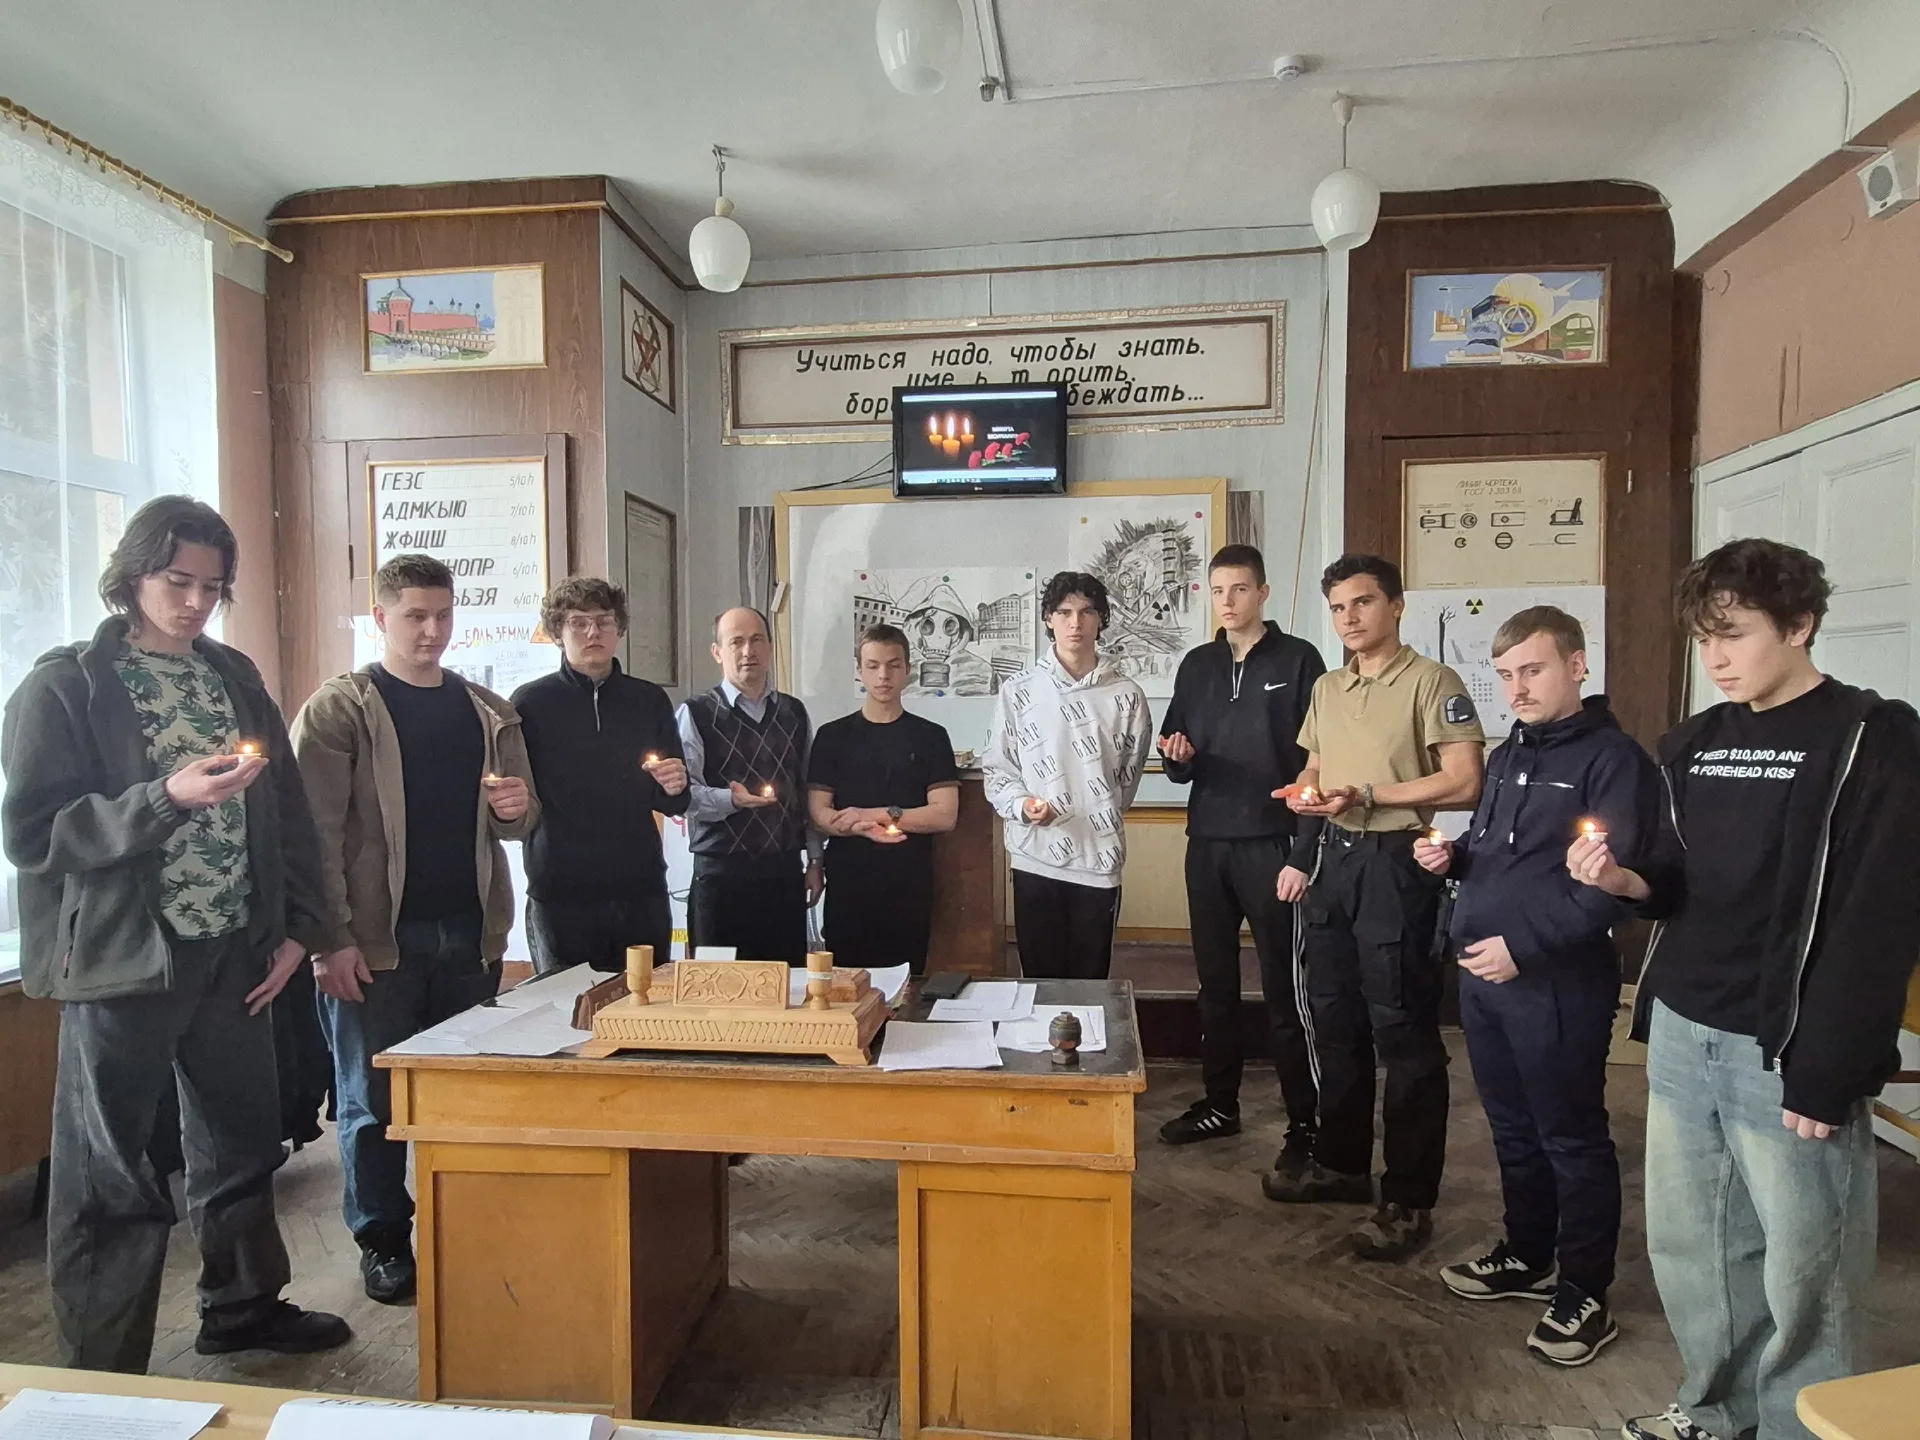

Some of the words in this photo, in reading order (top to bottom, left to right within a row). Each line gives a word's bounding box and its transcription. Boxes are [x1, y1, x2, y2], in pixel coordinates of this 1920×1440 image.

[796, 349, 907, 373] Учиться
[1010, 337, 1096, 364] чтобы
[381, 472, 425, 491] ГЕЗС
[382, 500, 467, 521] АДМКЫЮ
[383, 529, 446, 550] ЖФЩШ
[442, 557, 495, 576] НОПР
[1060, 700, 1087, 722] GAP
[1016, 721, 1040, 747] GAP
[1072, 735, 1099, 758] GAP
[1701, 749, 1729, 761] NEED
[1729, 748, 1776, 762] $10,000
[1032, 754, 1057, 779] GAP
[1689, 765, 1700, 775] A
[1699, 765, 1763, 778] FOREHEAD
[1764, 766, 1796, 780] KISS
[1087, 776, 1110, 796] GA
[1048, 836, 1074, 861] GAP
